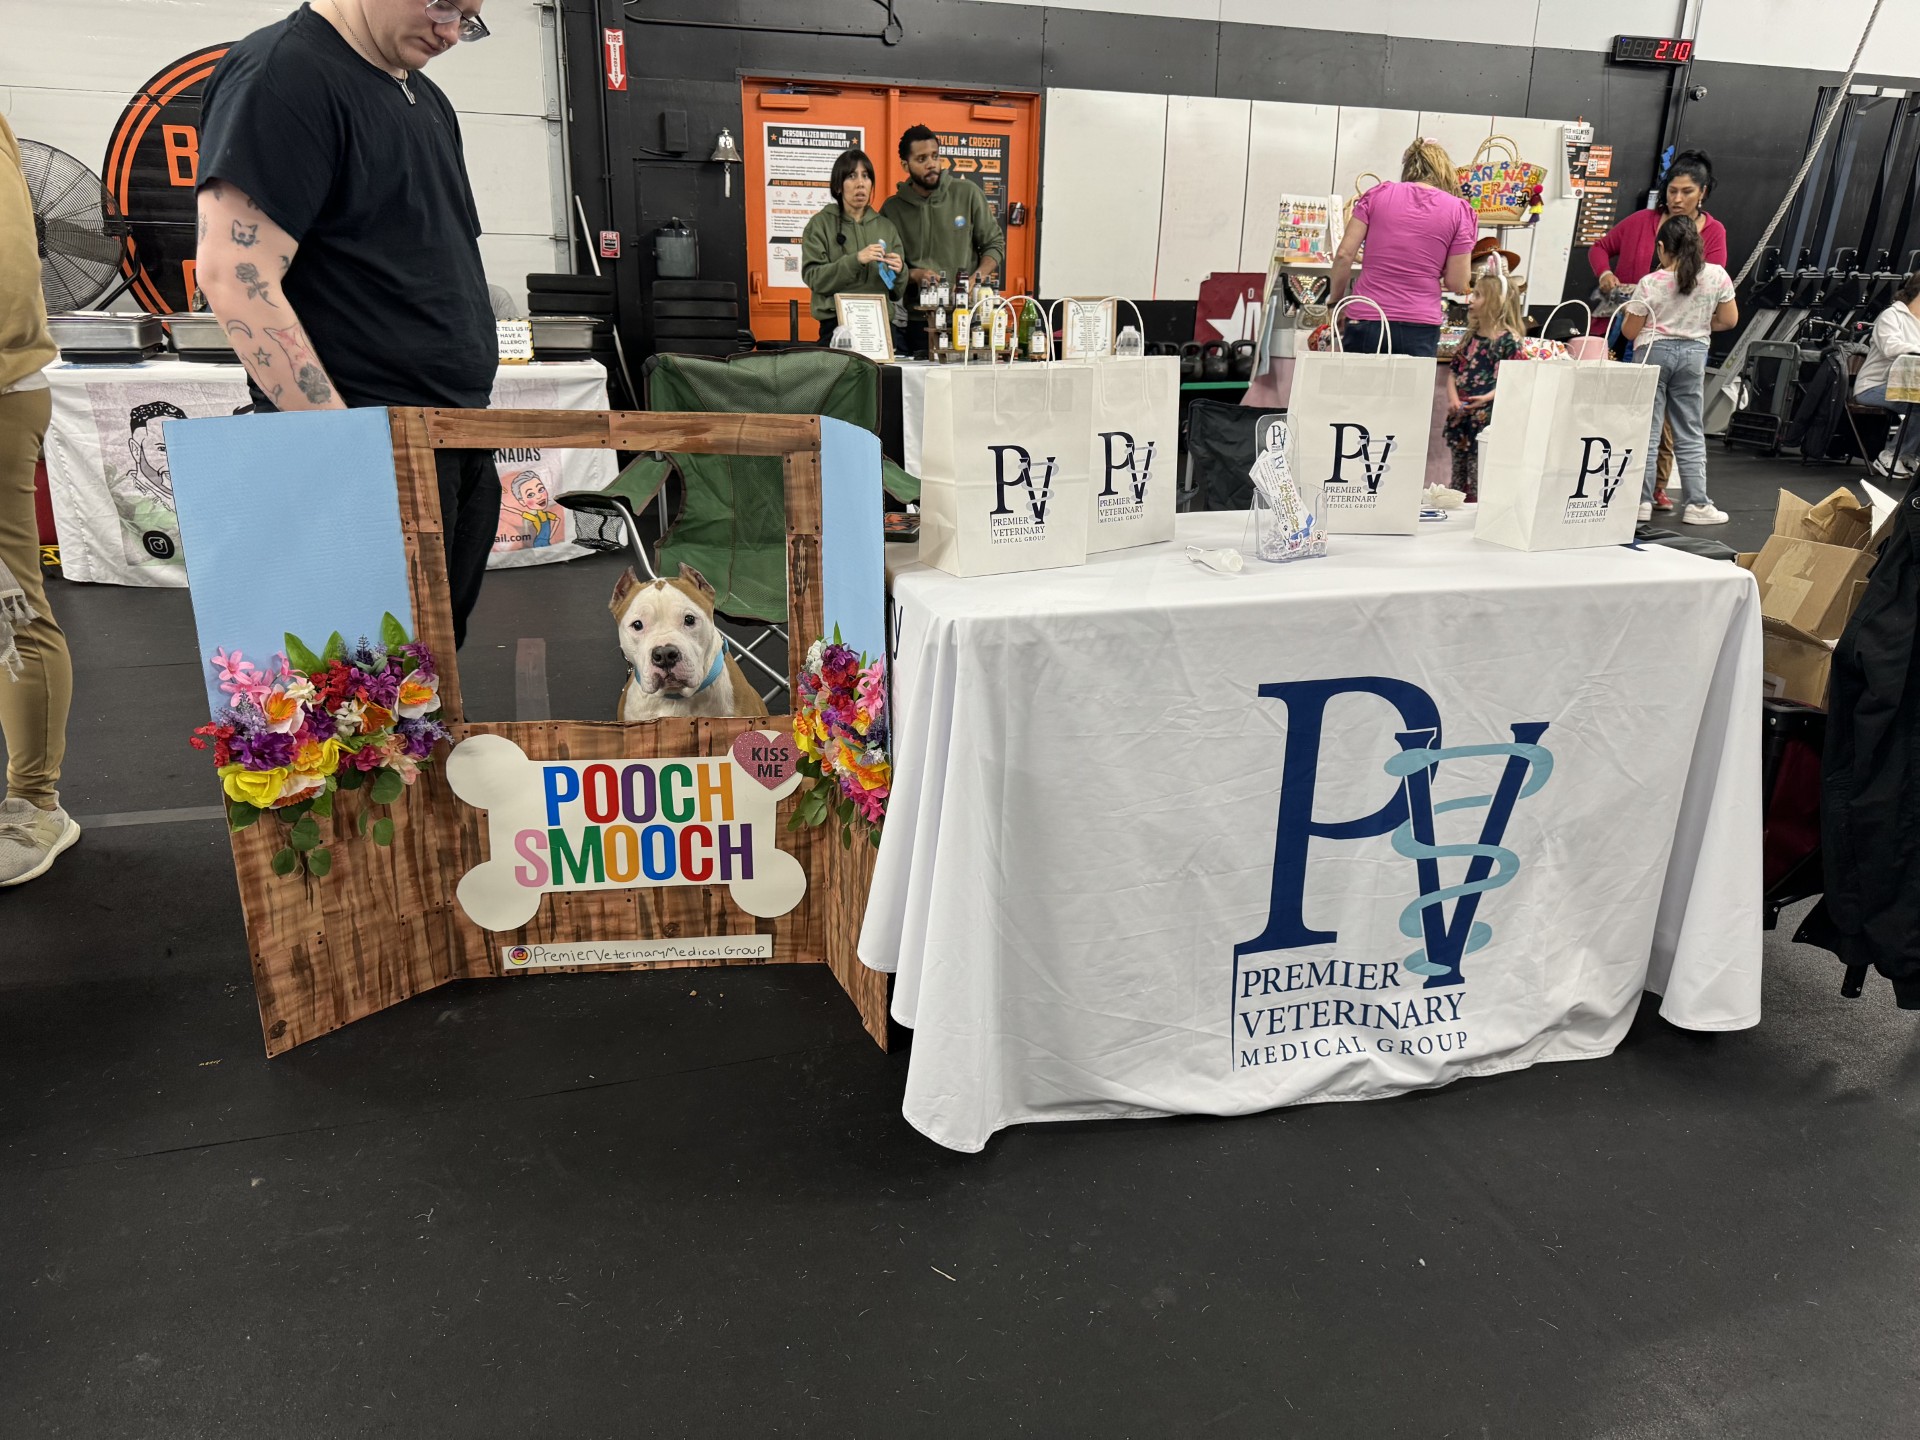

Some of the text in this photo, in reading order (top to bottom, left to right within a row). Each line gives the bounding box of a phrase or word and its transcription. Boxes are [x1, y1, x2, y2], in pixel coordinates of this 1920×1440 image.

[608, 34, 621, 43] FIRE
[782, 129, 847, 140] PERSONALIZED NUTRITION
[779, 138, 803, 146] COACHING
[808, 139, 850, 148] ACCOUNTABILITY
[969, 136, 1001, 148] CROSSFIT
[947, 147, 968, 156] HEALTH
[968, 148, 989, 157] BETTER
[990, 148, 1001, 158] LIFE
[493, 448, 540, 463] NADAS
[1100, 497, 1130, 507] PREMIER
[1568, 501, 1598, 509] PREMIER
[1100, 505, 1144, 516] VETERINARY
[1567, 510, 1608, 518] VETERINARY
[993, 516, 1030, 526] PREMIER
[993, 526, 1045, 536] VETERINARY
[752, 748, 788, 762] KISS
[757, 764, 783, 778] ME
[543, 762, 734, 826] POOCH
[514, 824, 754, 888] SMOOCH
[1240, 960, 1400, 998] PREMIER
[1240, 992, 1466, 1038] VETERINARY
[1240, 1030, 1468, 1068] MEDICAL GROUP
